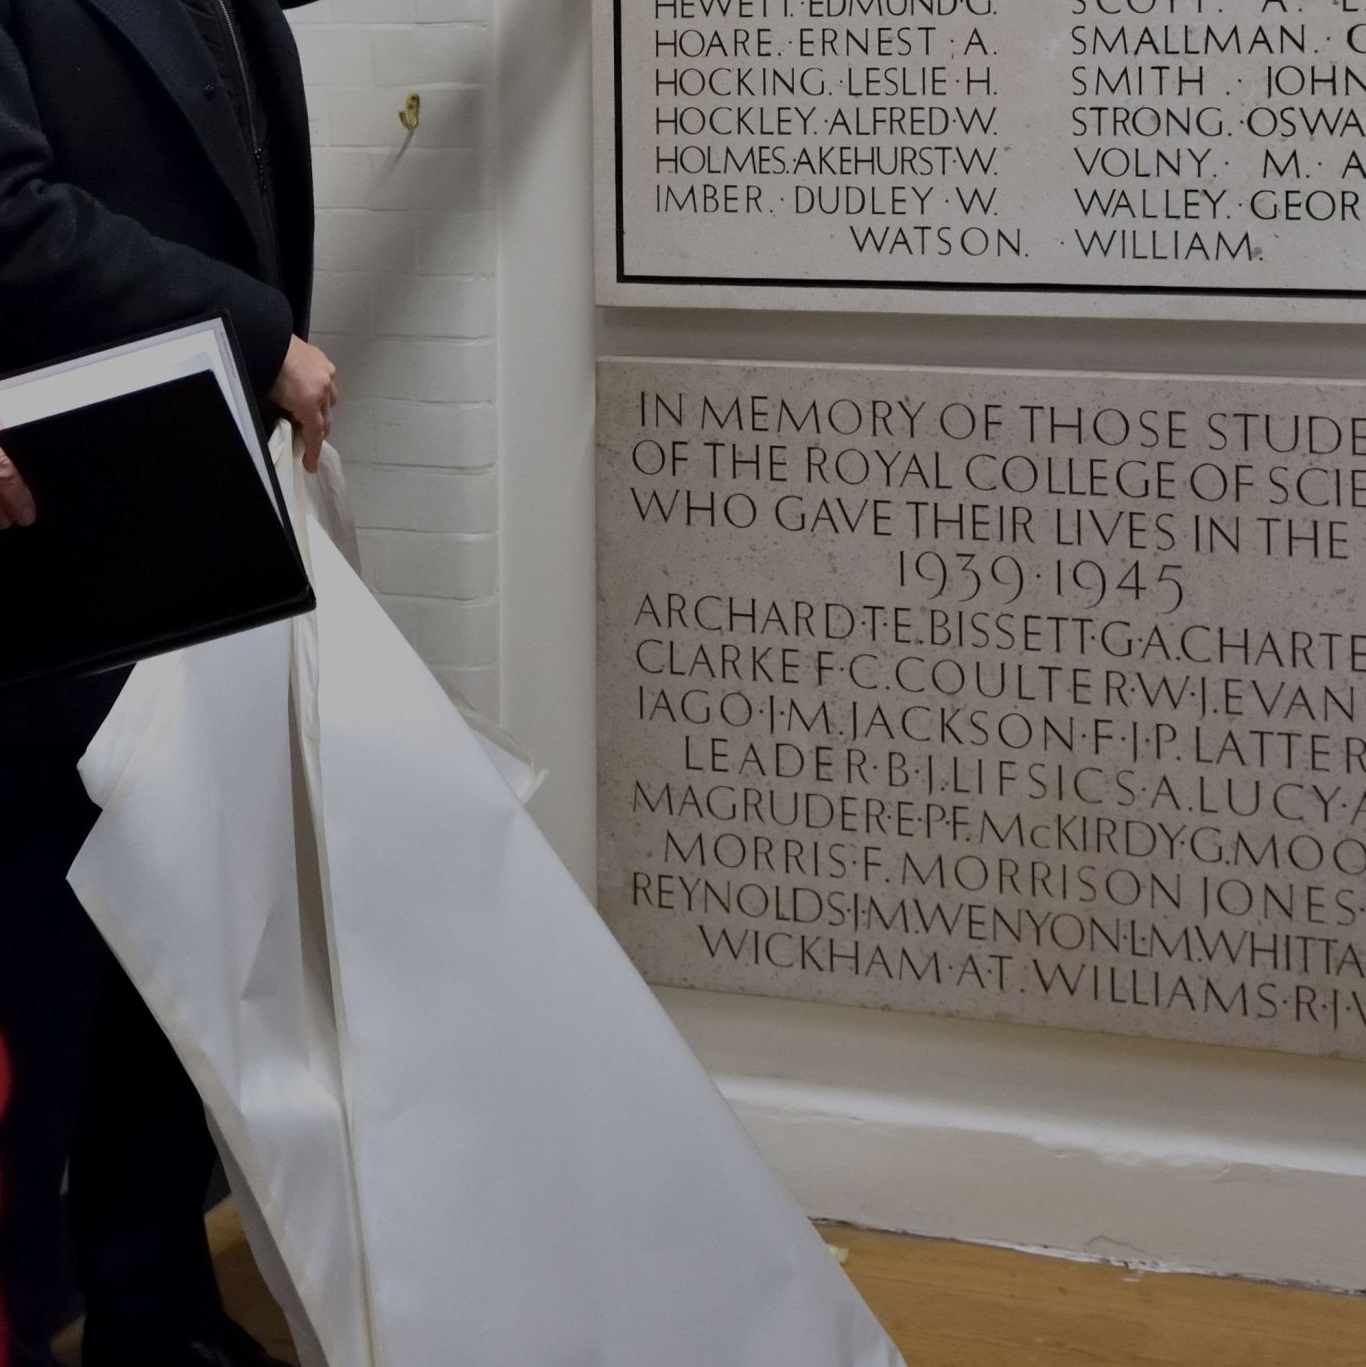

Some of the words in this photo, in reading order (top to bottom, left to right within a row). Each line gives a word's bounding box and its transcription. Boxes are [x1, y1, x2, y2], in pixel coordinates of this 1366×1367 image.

[800, 27, 936, 57] ERNEST
[848, 66, 946, 98] LESLIE
[828, 106, 949, 136] ALFRED
[793, 146, 953, 176] AKEHURST
[795, 185, 934, 215] DUDLEY
[641, 391, 682, 427] IN
[701, 396, 925, 438] MEMORY
[940, 403, 1002, 441] OF
[1019, 405, 1186, 449] THOSE
[632, 440, 688, 476] OF
[703, 442, 787, 482] THE
[807, 443, 952, 489] ROYAL
[966, 454, 1175, 499] COLLEGE
[1190, 463, 1254, 502] OF
[630, 487, 757, 528] WHO
[775, 495, 892, 536] GAVE
[906, 501, 1035, 543] THEIR
[1056, 508, 1175, 551] LIVES
[1195, 515, 1239, 554] IN
[1256, 517, 1348, 560] THE
[900, 550, 1024, 604] 1939
[1056, 559, 1183, 614] 1945
[635, 593, 855, 640] ARCHARD
[930, 609, 1094, 654] BISSETT
[636, 639, 799, 684] CLARKE
[895, 656, 1128, 707] COULTER
[852, 701, 1074, 752] JACKSON
[685, 735, 868, 784] LEADER
[1199, 776, 1341, 822] LUCY
[633, 780, 886, 834] MAGRUDER
[980, 810, 1186, 860] McKIRDY
[665, 830, 846, 878] MORRIS
[902, 852, 1180, 909] MORRISON
[1203, 876, 1355, 926] JONES
[632, 872, 845, 926] REYNOLDS
[913, 898, 1119, 952] WENYON
[698, 925, 941, 984] WICKHAM
[1032, 959, 1277, 1018] WILLIAMS
